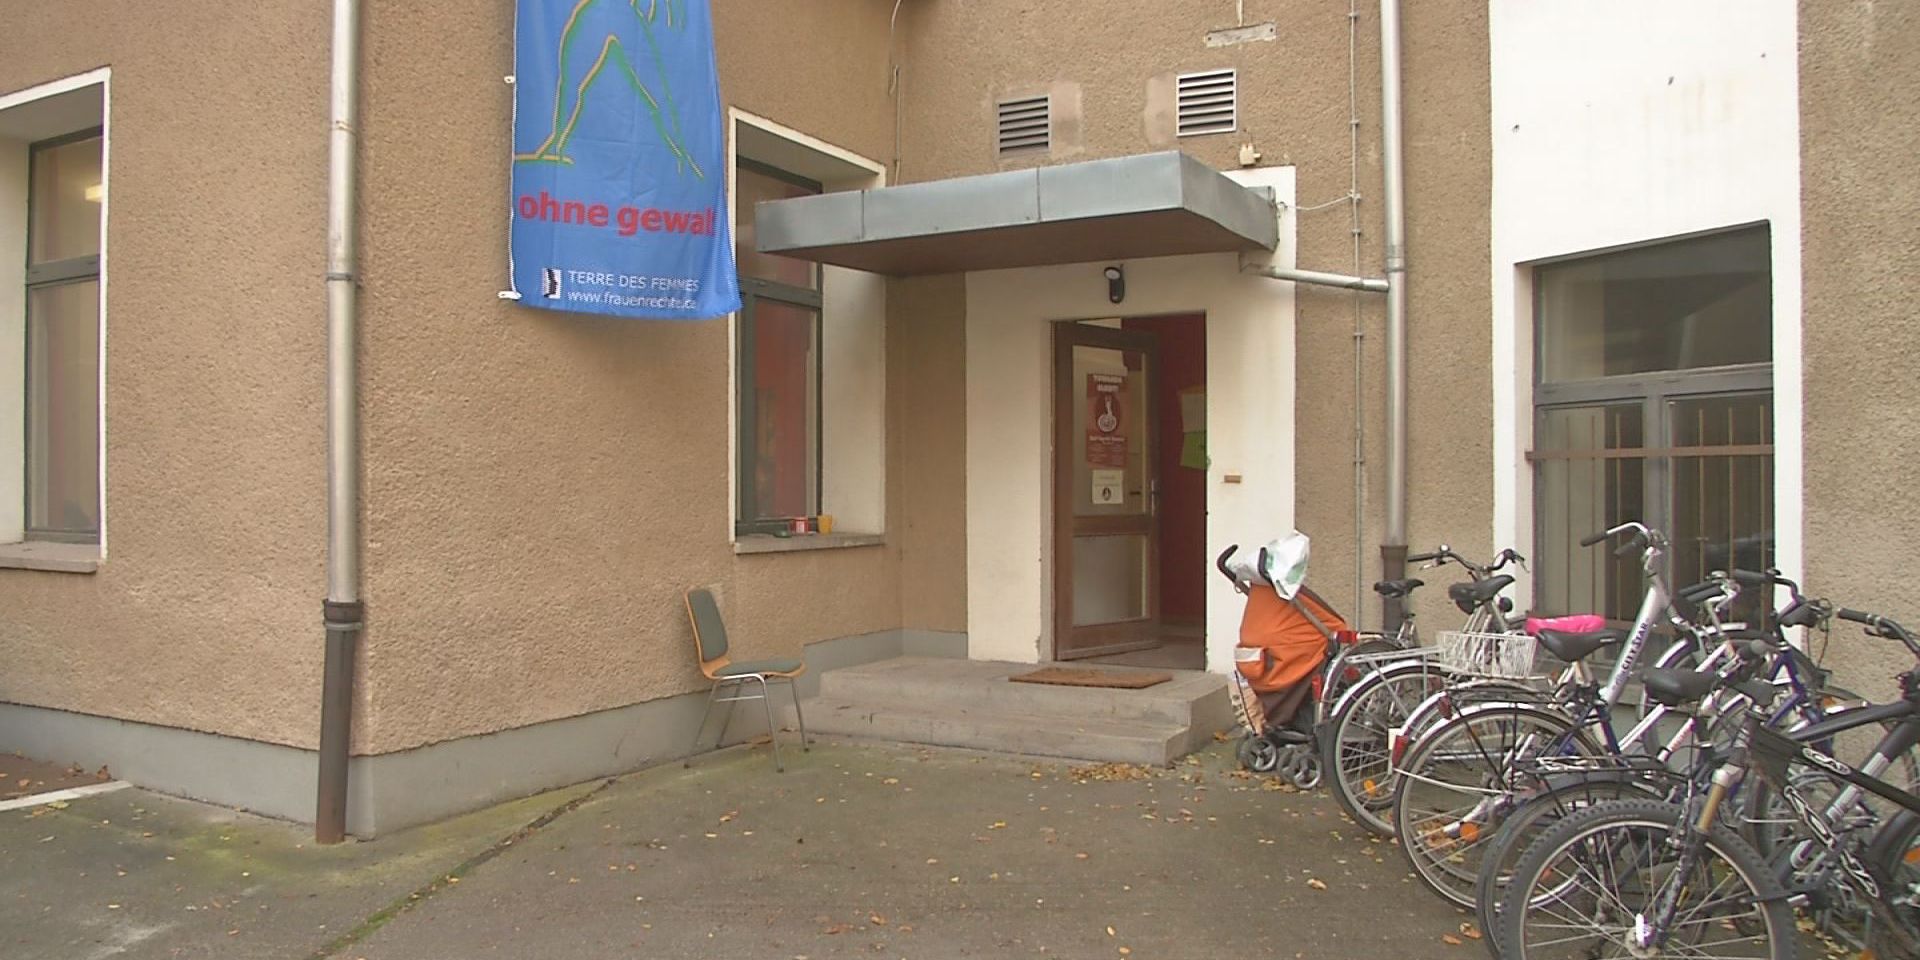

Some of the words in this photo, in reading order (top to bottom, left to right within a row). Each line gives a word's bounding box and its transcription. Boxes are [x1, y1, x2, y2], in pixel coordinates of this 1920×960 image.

[518, 192, 610, 228] ohne
[616, 205, 715, 238] gewal
[568, 270, 614, 287] TERRE
[619, 275, 647, 289] DES
[651, 276, 699, 292] FEMMES
